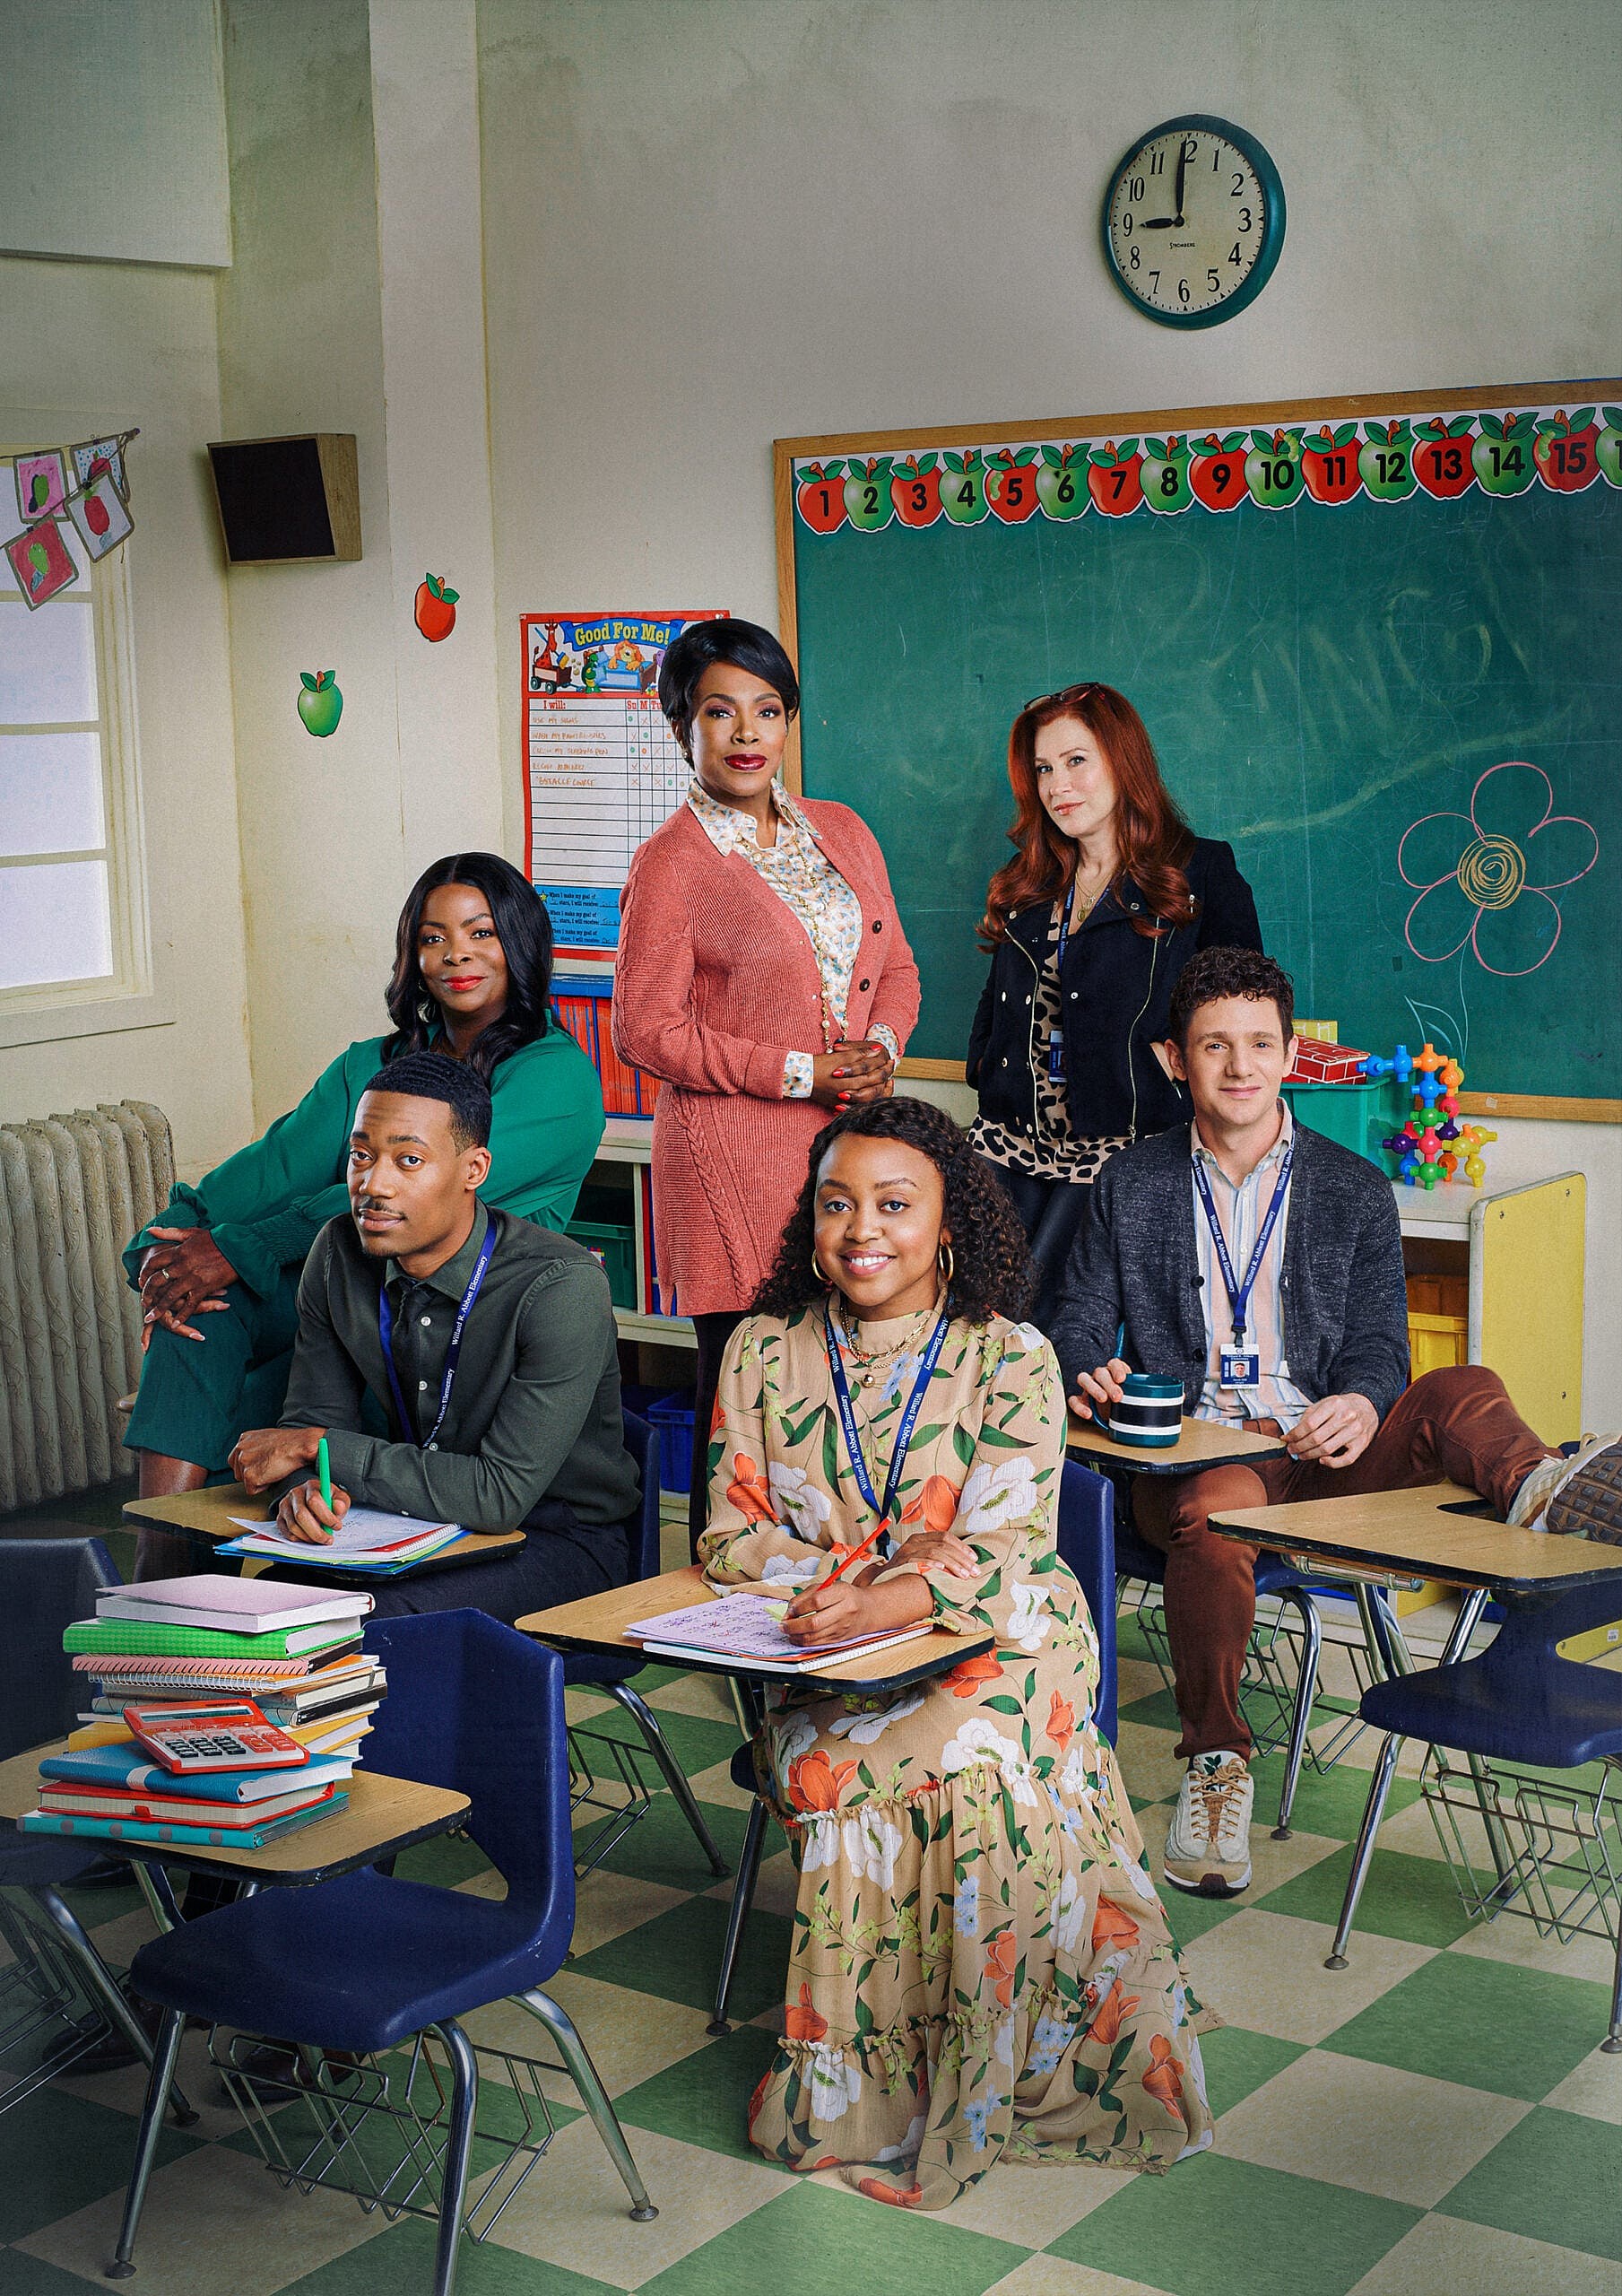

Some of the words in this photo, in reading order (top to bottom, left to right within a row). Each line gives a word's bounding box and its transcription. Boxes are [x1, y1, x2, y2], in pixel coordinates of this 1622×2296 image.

[1149, 152, 1165, 175] 11
[1181, 140, 1198, 163] 2
[1212, 148, 1220, 172] 1
[1128, 177, 1145, 202] 10
[1230, 173, 1245, 196] 2
[1123, 213, 1133, 237] 9
[1237, 207, 1252, 232] 3
[1130, 246, 1141, 270] 8
[1228, 242, 1242, 266] 4
[1149, 271, 1161, 294] 7
[1177, 279, 1190, 303] 6
[1207, 268, 1220, 292] 5
[820, 490, 829, 517] 1
[863, 486, 880, 514] 2
[911, 483, 927, 512] 3
[957, 480, 977, 509] 4
[1006, 477, 1023, 507] 5
[1057, 474, 1075, 503] 6
[1110, 470, 1127, 500] 7
[1160, 466, 1178, 497] 8
[1211, 464, 1231, 493] 9
[1260, 459, 1295, 491] 10
[1322, 456, 1347, 486] 11
[1374, 452, 1407, 484] 12
[1429, 449, 1463, 481] 13
[1488, 446, 1524, 478] 14
[1553, 443, 1587, 474] 15
[575, 622, 611, 646] Good
[612, 622, 638, 639] For
[640, 622, 670, 645] Me!
[543, 700, 548, 709] I
[549, 700, 566, 709] will:
[627, 700, 637, 709] Su
[639, 700, 648, 709] M
[650, 700, 663, 709] Tu
[1210, 1214, 1219, 1236] Willard
[1261, 1211, 1276, 1239] Elementary
[1215, 1234, 1222, 1243] R.
[1254, 1238, 1265, 1257] Abbott
[1218, 1242, 1227, 1261] Abbott
[1253, 1257, 1260, 1265] R.
[1223, 1261, 1235, 1292] Elementary
[1244, 1265, 1256, 1287] Willard
[452, 1322, 463, 1346] Willard
[458, 1313, 465, 1323] R.
[462, 1290, 474, 1314] Abbott
[470, 1256, 488, 1290] Elementary
[830, 1349, 840, 1373] Willard
[925, 1338, 942, 1370] Elementary
[441, 1369, 455, 1404] Elementary
[841, 1395, 854, 1430] Elementary
[909, 1392, 924, 1414] Willard
[906, 1413, 915, 1423] R.
[848, 1429, 860, 1455] Abbott
[900, 1422, 913, 1448] Abbott
[854, 1454, 861, 1465] R.
[889, 1448, 906, 1489] Elementary
[856, 1464, 868, 1492] Willard
